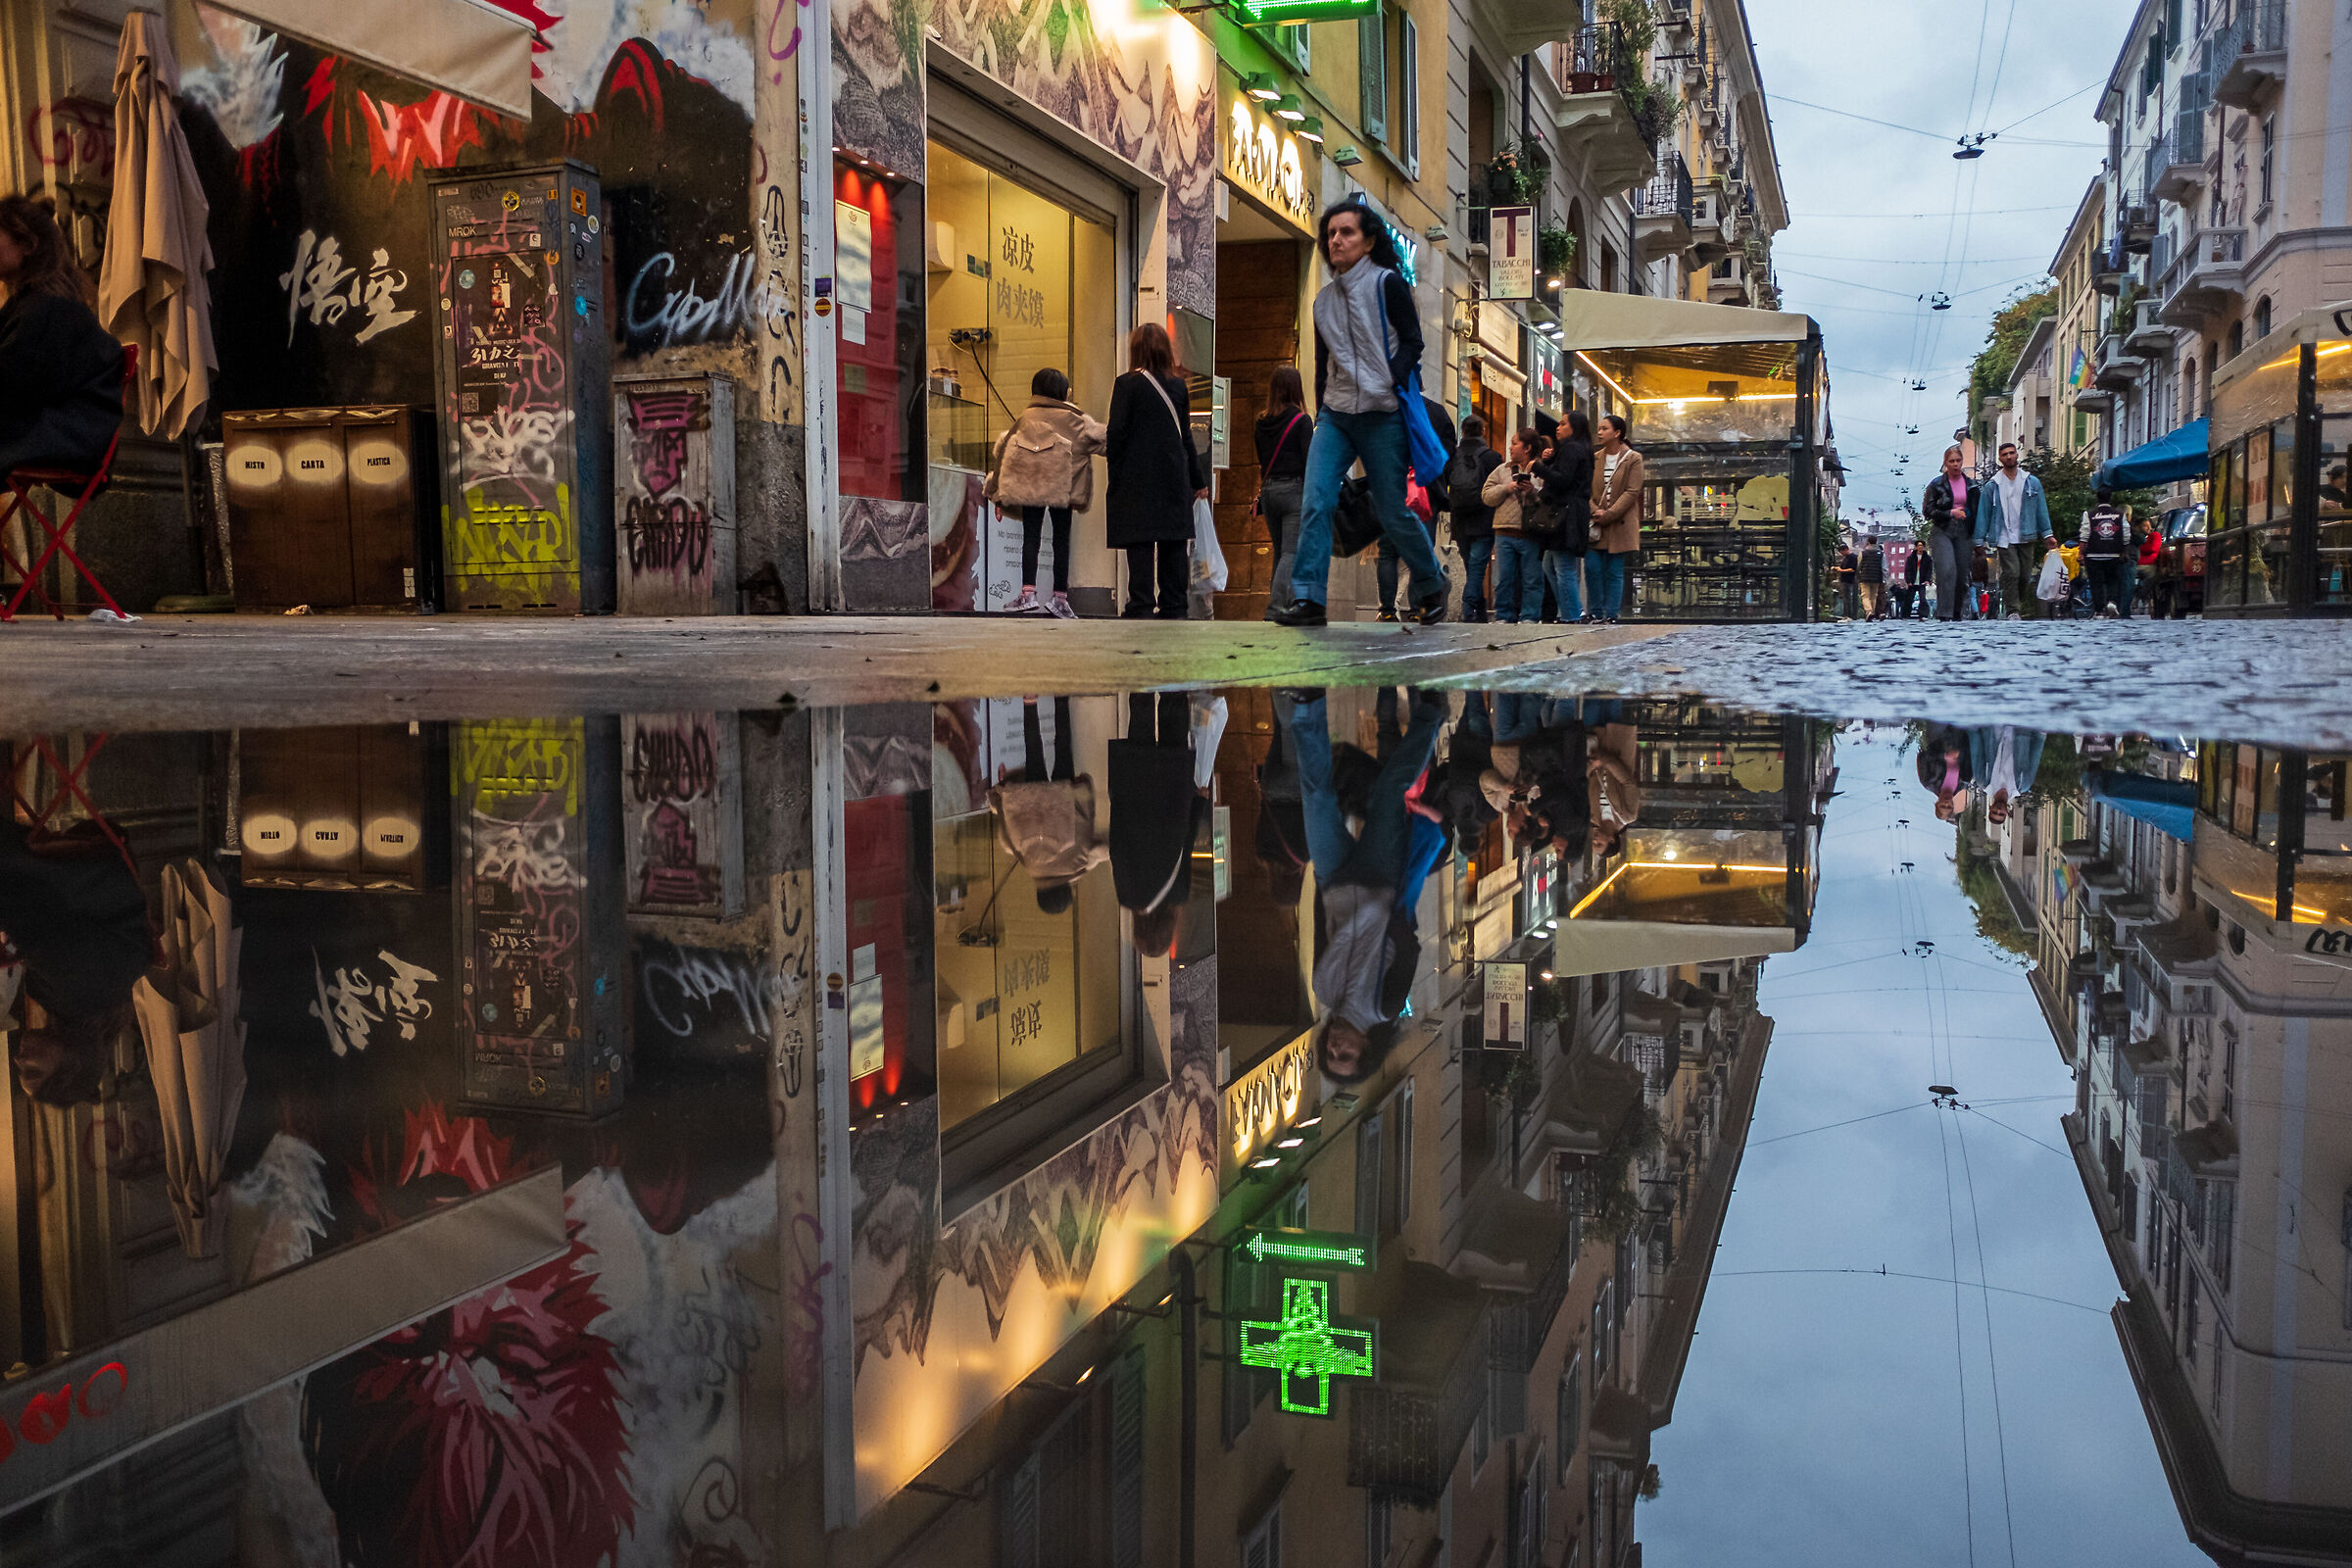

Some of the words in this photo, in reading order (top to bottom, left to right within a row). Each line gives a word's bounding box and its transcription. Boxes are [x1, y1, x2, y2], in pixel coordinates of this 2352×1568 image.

[448, 225, 477, 238] MROK
[1002, 225, 1035, 274] 凉皮
[1492, 259, 1531, 269] TABACCHI
[996, 277, 1045, 329] 肉夹馍
[245, 461, 266, 469] MISTO
[300, 460, 325, 469] CARTA
[367, 457, 391, 466] PLASTICA
